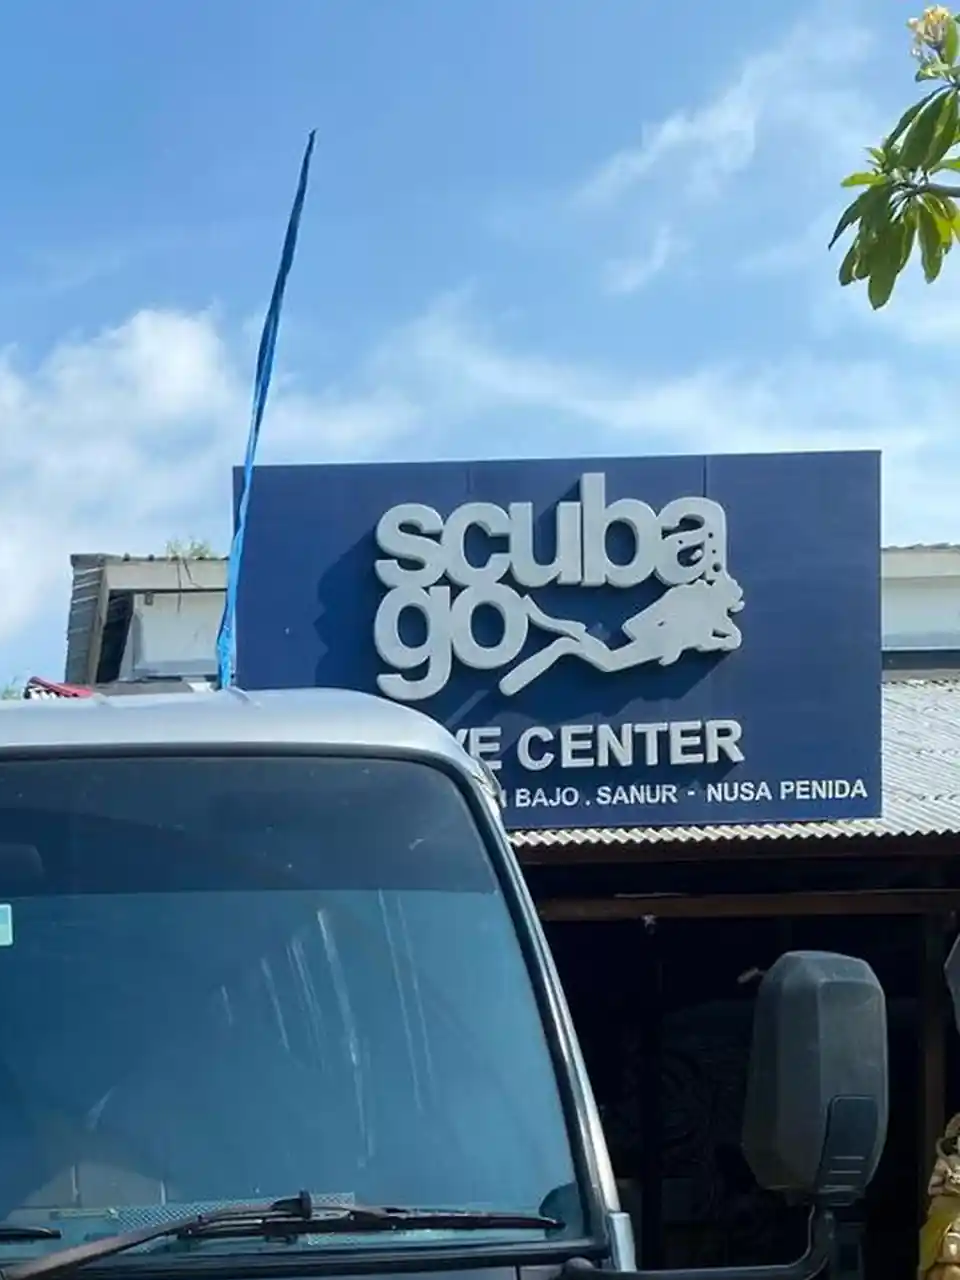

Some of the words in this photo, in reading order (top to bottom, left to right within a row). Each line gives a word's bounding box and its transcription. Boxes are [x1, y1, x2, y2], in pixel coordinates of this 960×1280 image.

[375, 472, 727, 589] scuba
[374, 584, 529, 700] go
[517, 719, 745, 771] CENTER
[515, 786, 579, 807] BAJO
[596, 783, 677, 805] SANUR
[707, 781, 773, 801] NUSA
[780, 779, 868, 800] PENIDA
